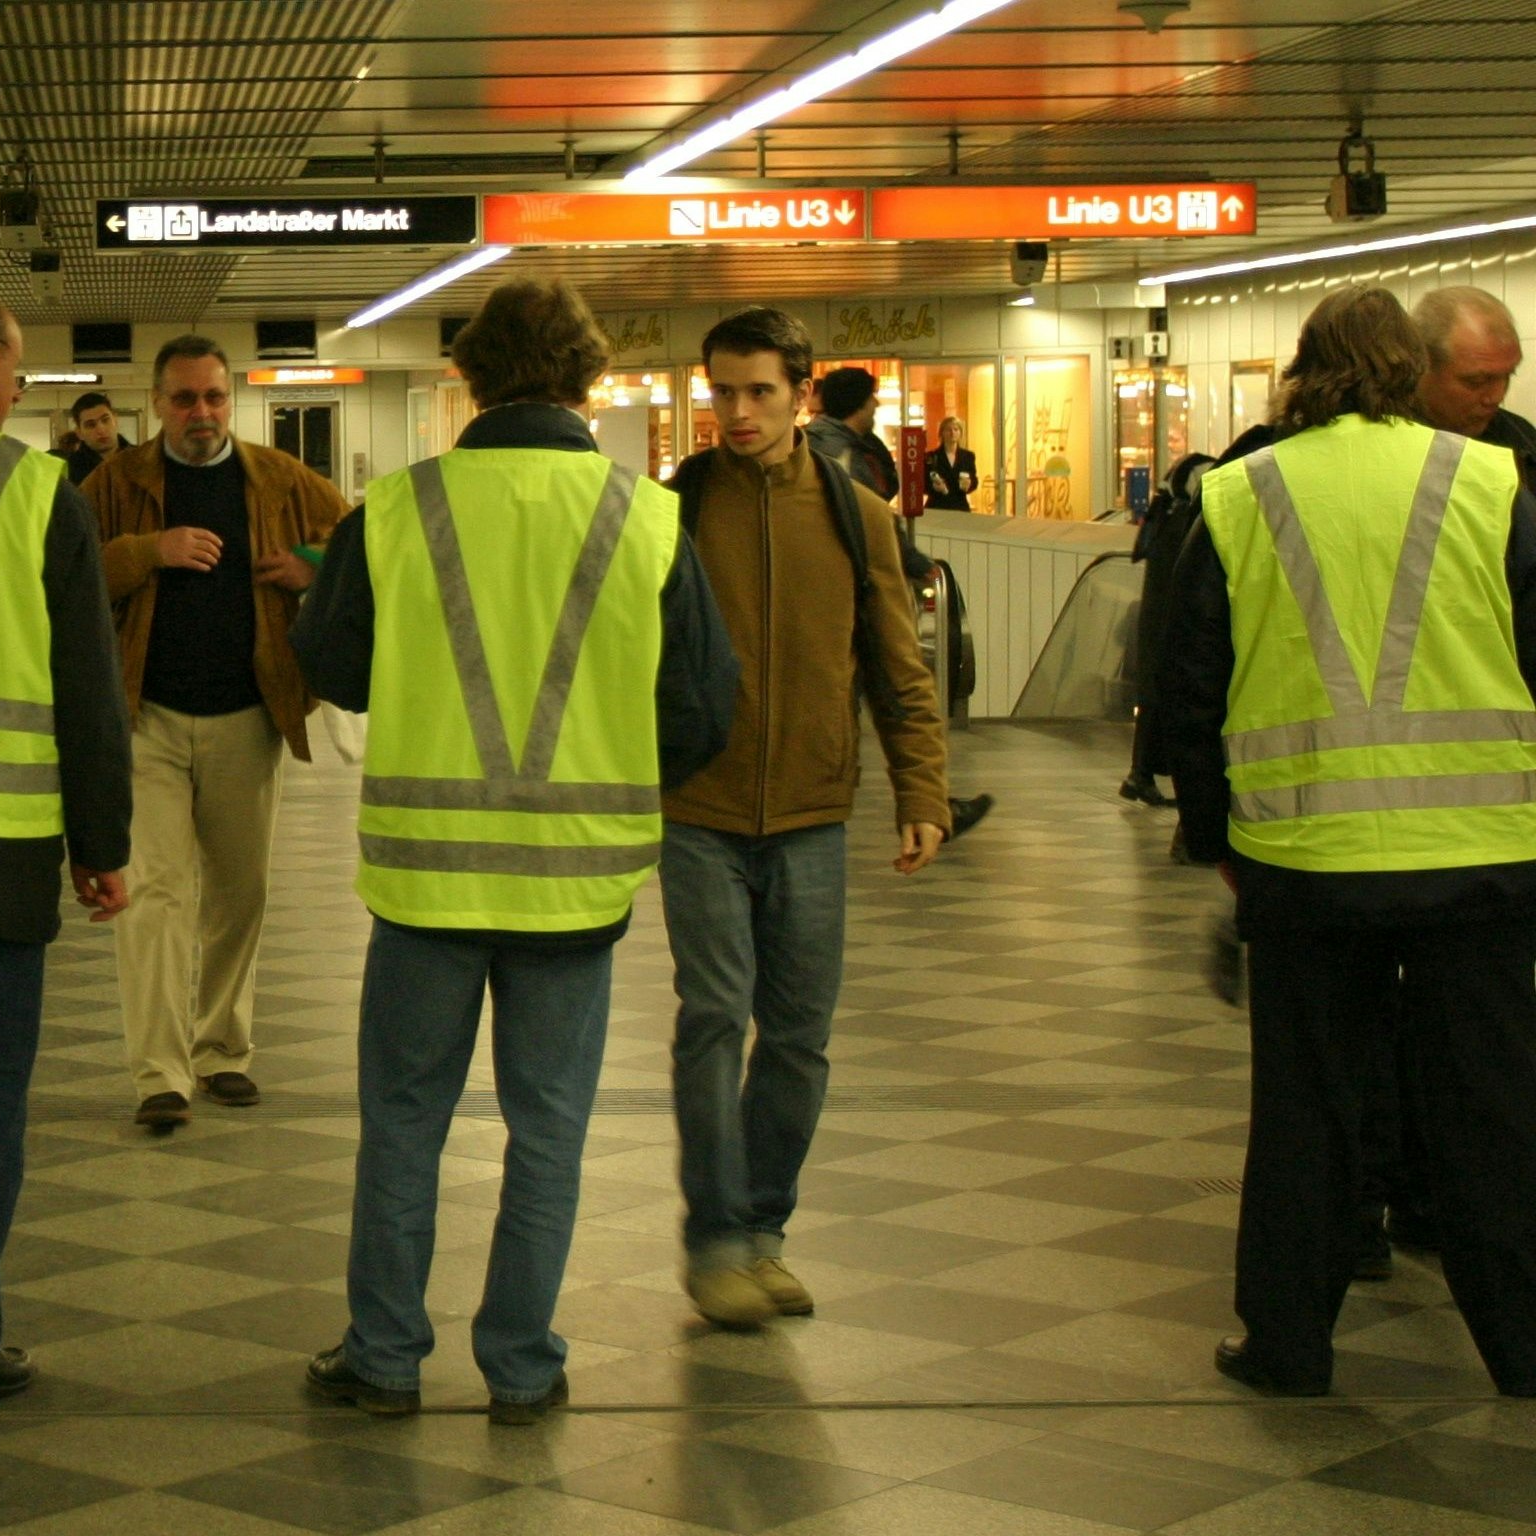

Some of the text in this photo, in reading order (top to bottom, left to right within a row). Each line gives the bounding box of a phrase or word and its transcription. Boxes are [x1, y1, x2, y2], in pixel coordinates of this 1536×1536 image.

[200, 208, 409, 233] Landstraßer Markt
[708, 198, 831, 229] Linie U3
[1048, 194, 1174, 225] Linie U3
[907, 435, 918, 473] NOT
